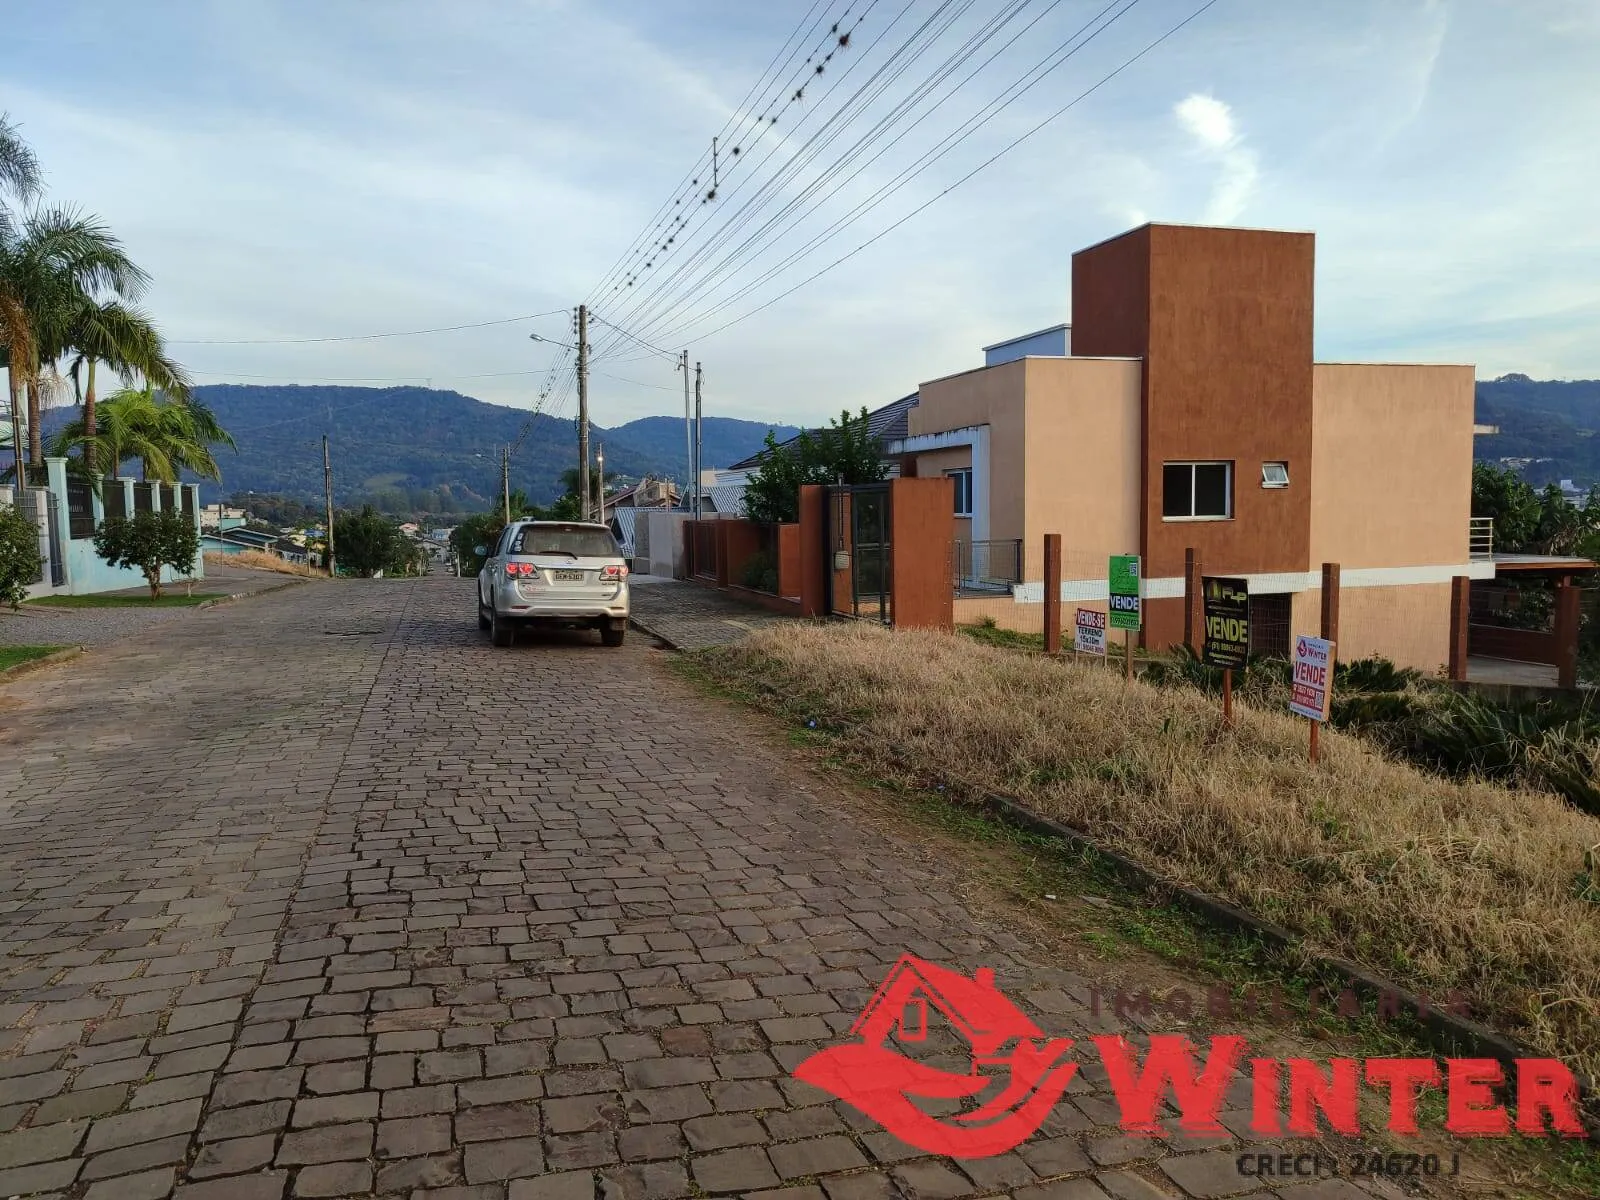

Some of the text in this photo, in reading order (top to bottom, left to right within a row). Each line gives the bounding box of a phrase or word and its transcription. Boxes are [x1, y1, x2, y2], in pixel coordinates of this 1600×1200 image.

[1110, 595, 1139, 611] VENDE
[1077, 609, 1105, 629] VENDE-SE
[1206, 615, 1248, 643] VENDE
[1295, 660, 1326, 687] VENDE
